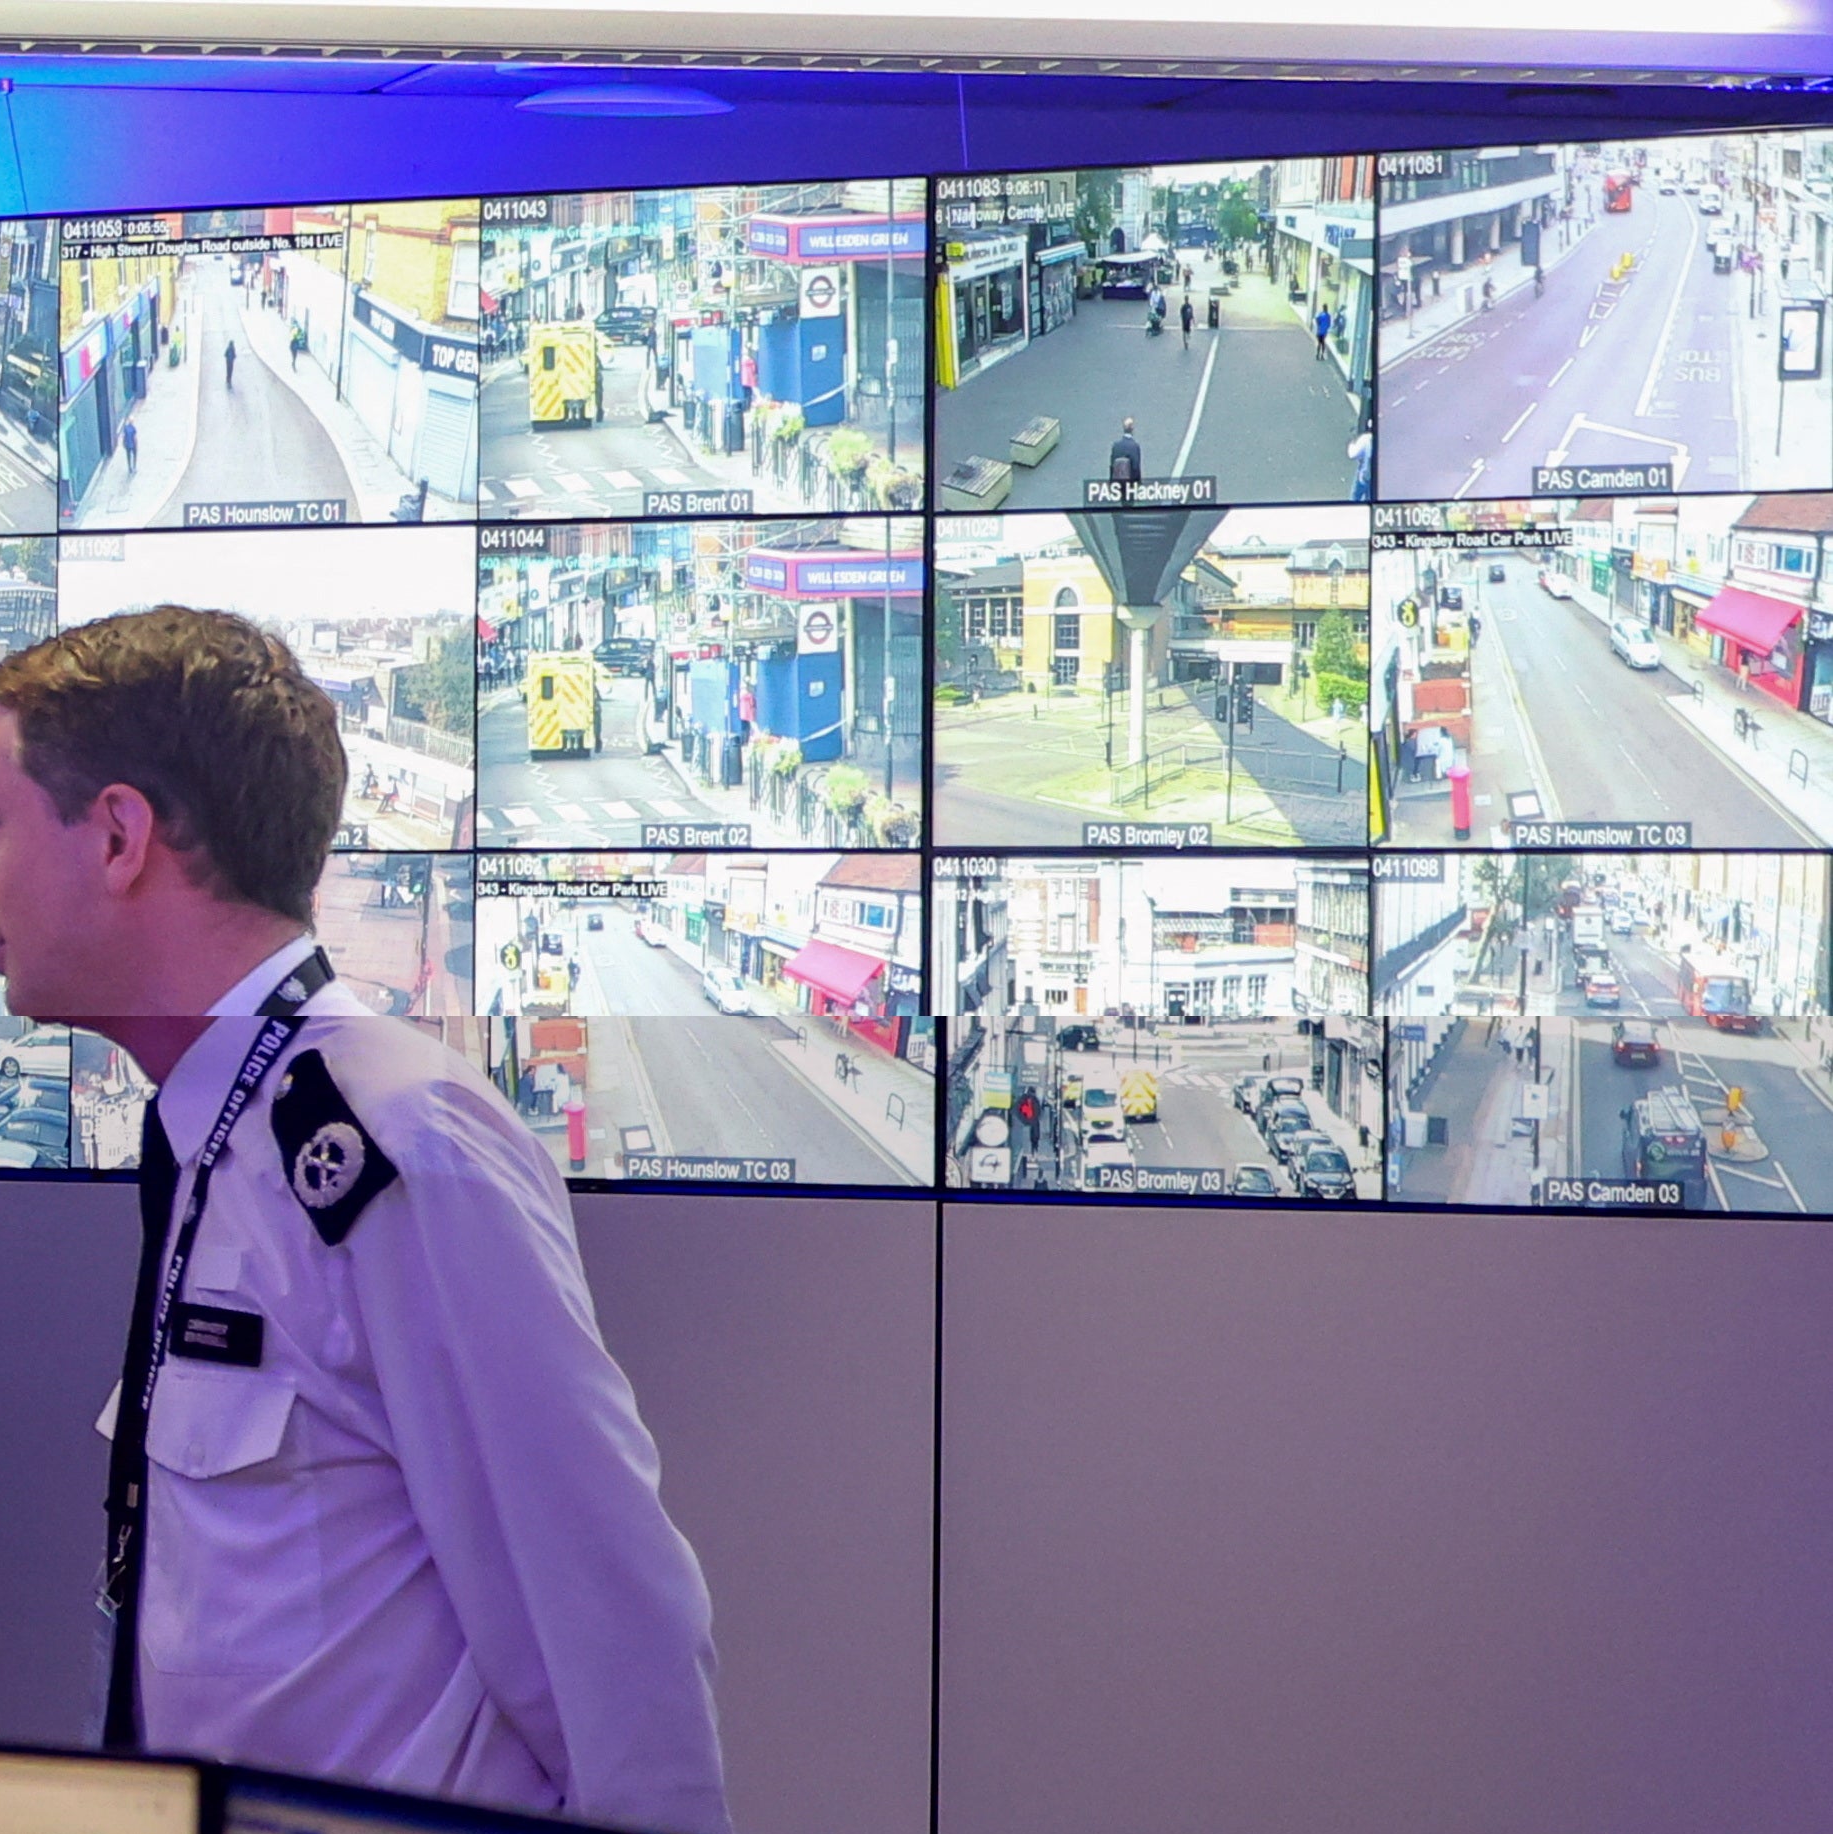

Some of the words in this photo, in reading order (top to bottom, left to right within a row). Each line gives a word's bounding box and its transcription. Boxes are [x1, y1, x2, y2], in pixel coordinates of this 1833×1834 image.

[1378, 156, 1443, 175] 0411081
[939, 178, 999, 198] 0411083
[484, 200, 547, 220] 0411043
[1047, 202, 1075, 218] LIVE
[64, 222, 123, 239] 0411053
[62, 245, 81, 259] 317
[90, 245, 115, 259] High
[117, 243, 147, 256] Street
[156, 242, 199, 256] Douglas
[202, 239, 229, 253] Road
[232, 238, 270, 252] outside
[294, 236, 313, 248] 194
[316, 235, 342, 247] LIVE
[1537, 471, 1574, 489] PAS
[1577, 468, 1644, 488] Camden
[1648, 467, 1667, 486] 01
[1088, 483, 1121, 501] PAS
[1125, 480, 1189, 502] Hackney
[1192, 480, 1210, 499] 01
[648, 494, 681, 512] PAS
[686, 493, 726, 512] Brent
[730, 492, 748, 511] 01
[188, 506, 221, 525] PAS
[225, 502, 294, 525] Hounslow
[297, 500, 319, 522] TC
[322, 500, 340, 521] 01
[1375, 507, 1441, 527] 0411062
[481, 529, 544, 548] 0411044
[1373, 533, 1397, 550] 343
[1406, 534, 1454, 552] Kingsley
[1456, 532, 1488, 548] Road
[1491, 531, 1512, 547] Car
[1514, 530, 1542, 546] Park
[1544, 530, 1572, 545] LIVE
[645, 826, 680, 846] PAS
[684, 825, 725, 845] Brent
[729, 825, 748, 844] 02
[1087, 826, 1121, 845] PAS
[1125, 825, 1185, 849] Bromley
[1189, 825, 1208, 845] 02
[1516, 826, 1551, 846] PAS
[1555, 825, 1632, 845] Hounslow
[1637, 824, 1661, 845] TC
[1665, 825, 1686, 844] 03
[479, 856, 542, 876] 0411062
[934, 857, 996, 876] 0411030
[1373, 858, 1439, 878] 0411098
[477, 882, 501, 897] 343
[509, 881, 556, 899] Kingsley
[557, 881, 588, 897] Road
[589, 881, 611, 897] Car
[612, 881, 639, 897] Park
[641, 881, 667, 897] LIVE
[238, 1019, 291, 1089] POLICE
[628, 1159, 662, 1178] PAS
[667, 1159, 739, 1180] Hounslow
[743, 1160, 768, 1181] TC
[771, 1161, 790, 1181] 03
[1100, 1169, 1133, 1188] PAS
[1137, 1169, 1196, 1194] Bromley
[1200, 1172, 1220, 1192] 03
[1548, 1181, 1585, 1202] PAS
[1588, 1182, 1655, 1204] Camden
[1658, 1184, 1680, 1204] 03
